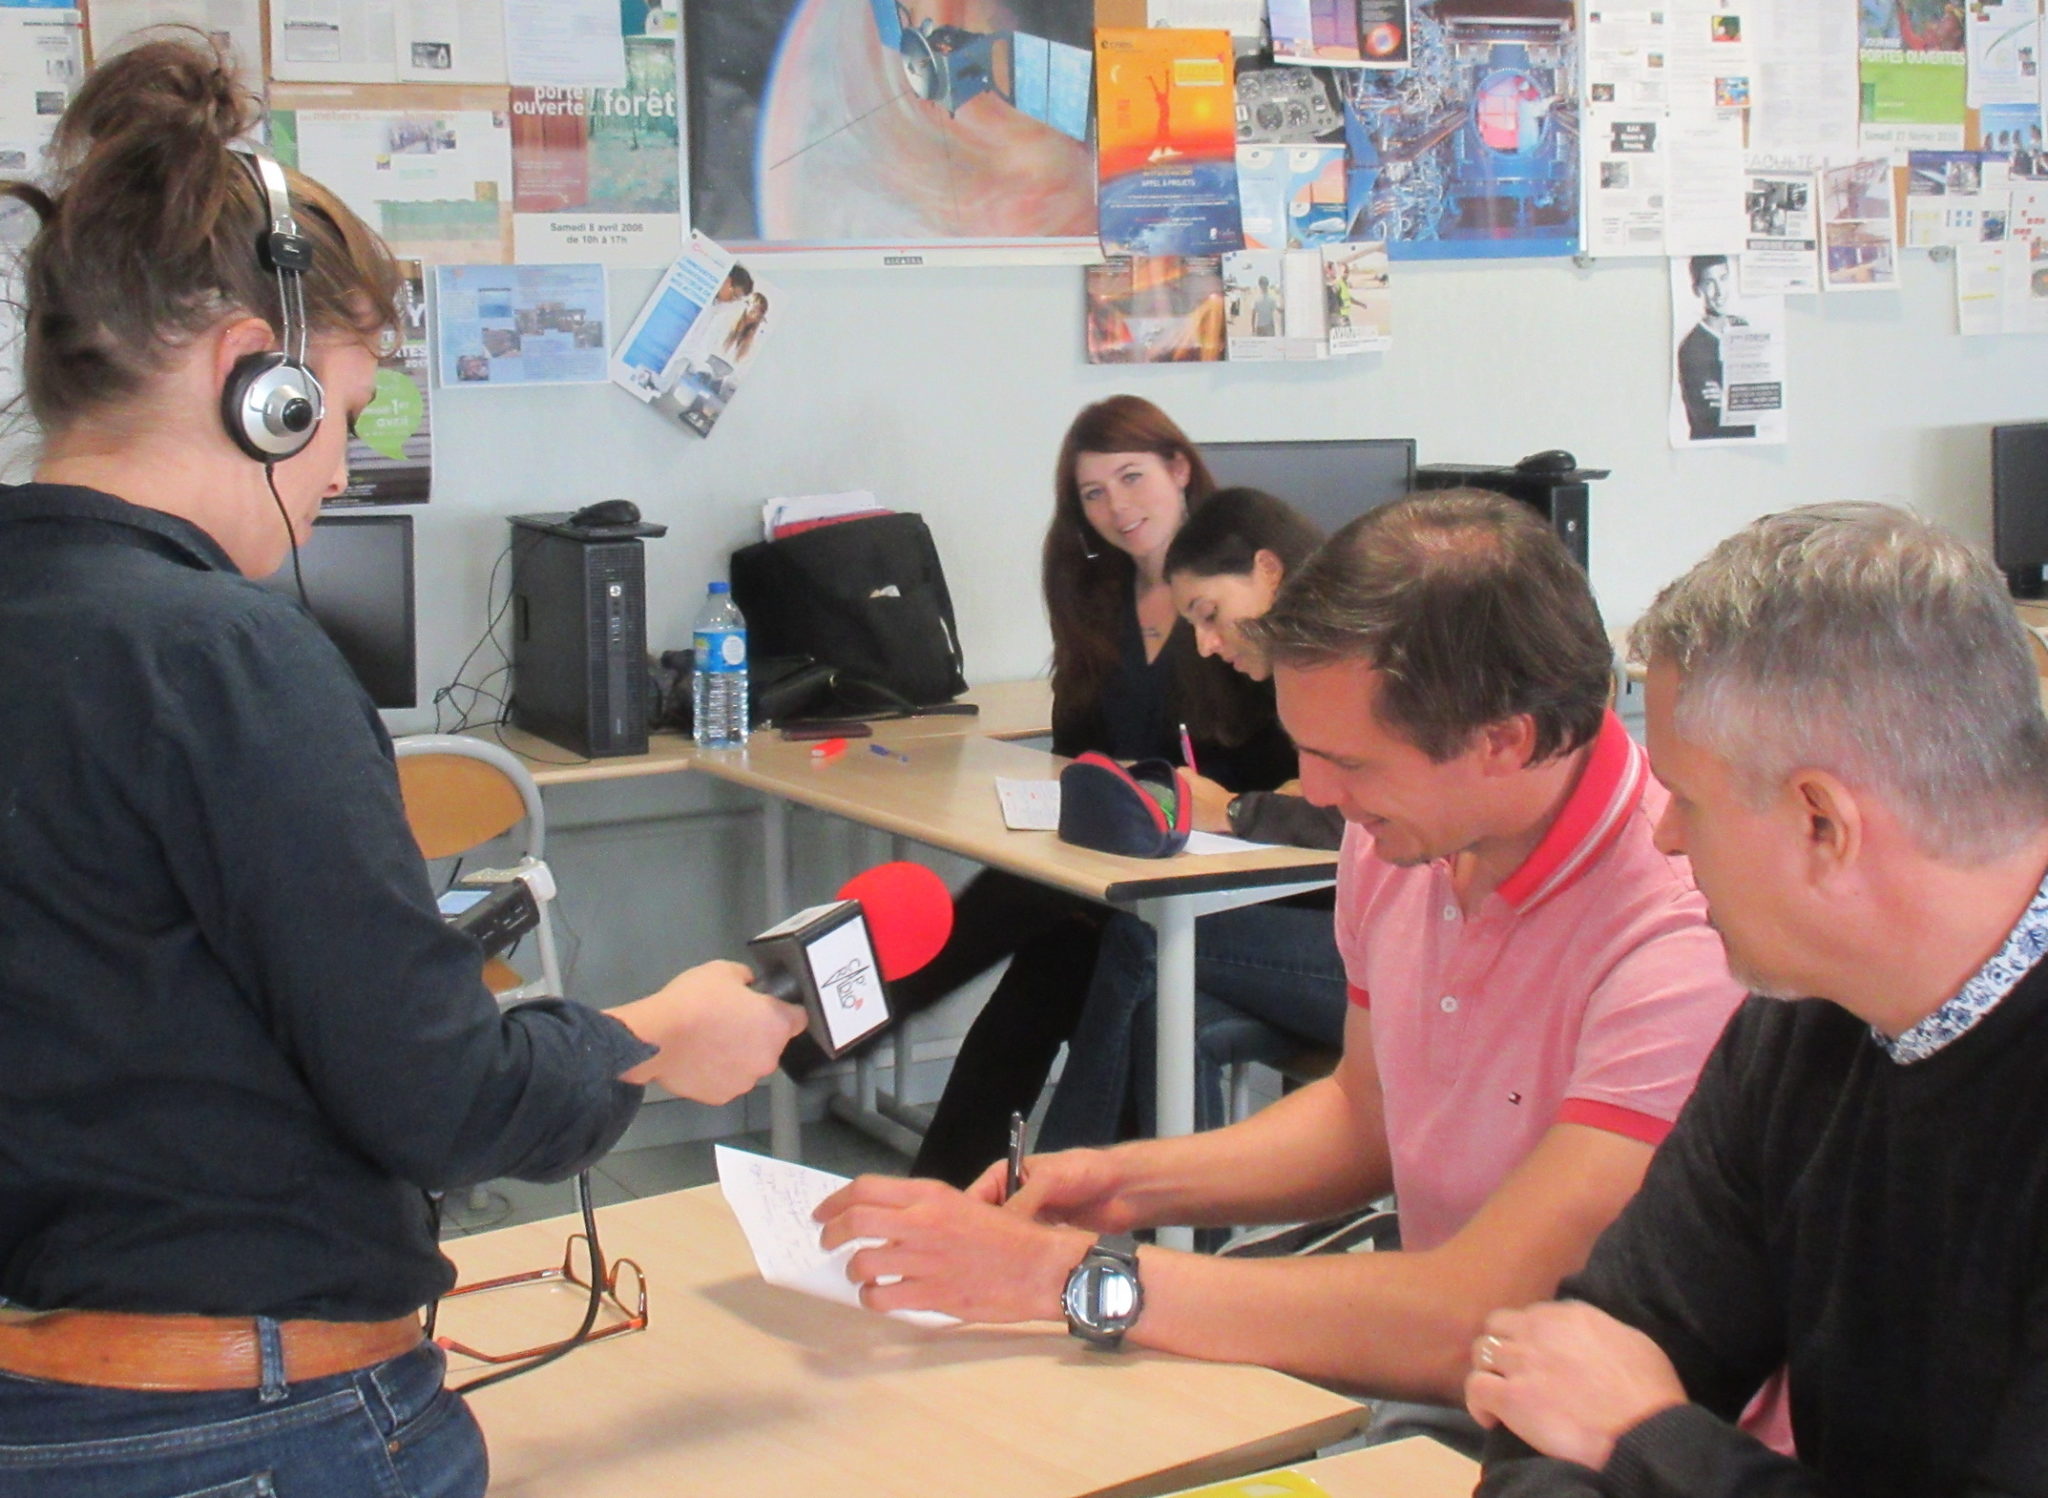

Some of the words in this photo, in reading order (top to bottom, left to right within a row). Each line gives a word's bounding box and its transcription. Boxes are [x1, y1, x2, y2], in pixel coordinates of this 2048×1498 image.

[534, 86, 584, 102] porte
[604, 87, 675, 117] forêt
[513, 99, 584, 116] ouverte
[550, 222, 586, 232] Samedi
[598, 222, 618, 232] avril
[566, 236, 578, 244] de
[582, 236, 599, 244] 10h
